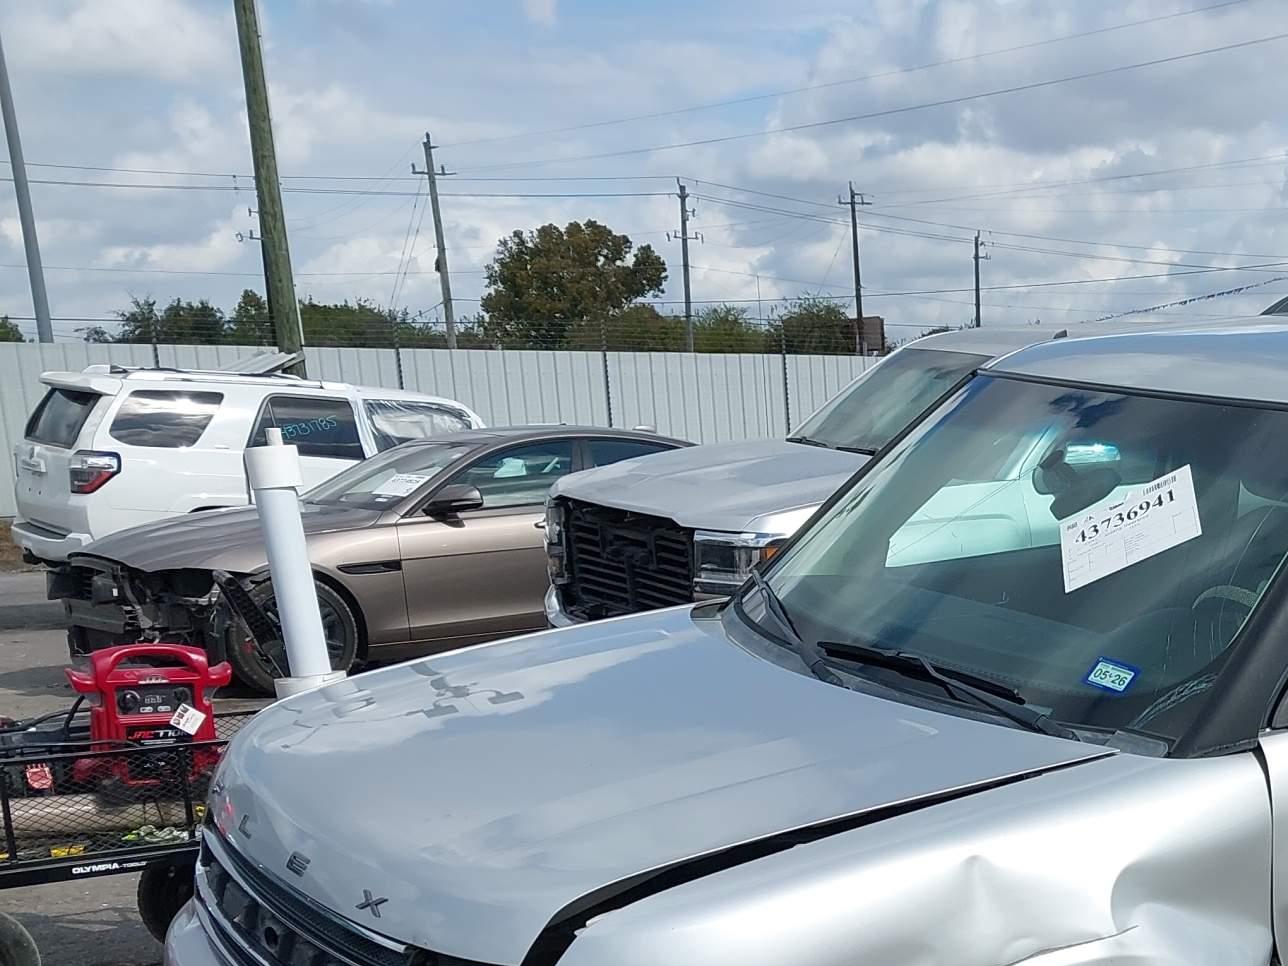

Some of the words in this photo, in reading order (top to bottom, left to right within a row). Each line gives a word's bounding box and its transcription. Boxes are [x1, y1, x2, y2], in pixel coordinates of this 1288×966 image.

[1075, 489, 1175, 543] 43736941
[1093, 668, 1110, 680] 05
[1110, 673, 1128, 686] 26
